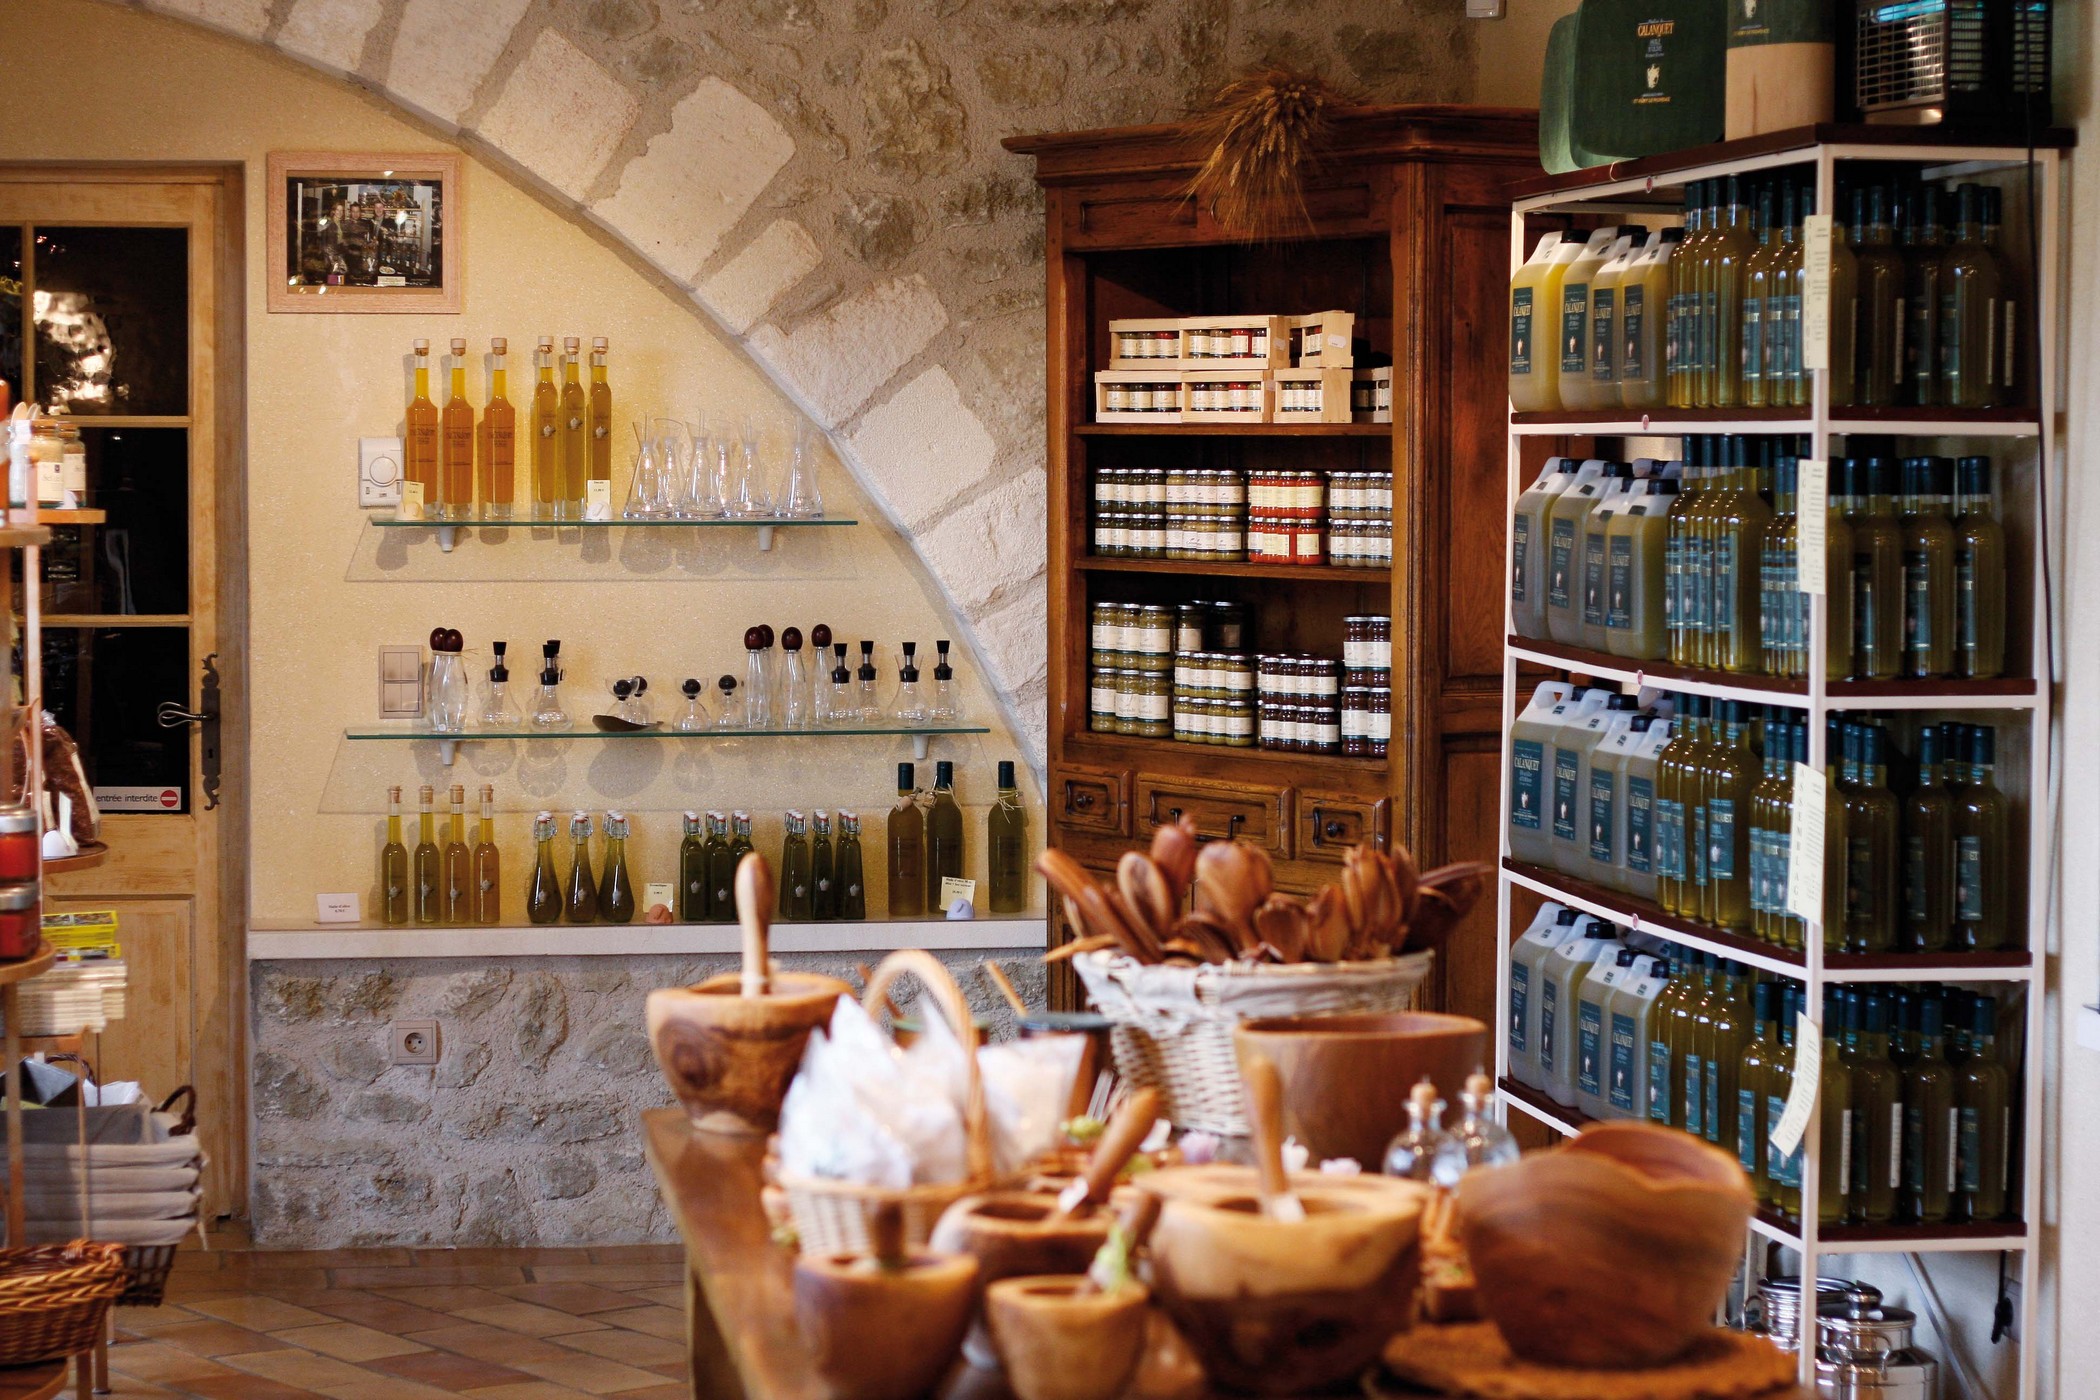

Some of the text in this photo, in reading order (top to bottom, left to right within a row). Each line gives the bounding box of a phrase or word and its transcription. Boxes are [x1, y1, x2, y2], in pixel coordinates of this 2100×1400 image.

[1638, 22, 1675, 37] CALANQUET
[96, 793, 158, 802] entrée interdite
